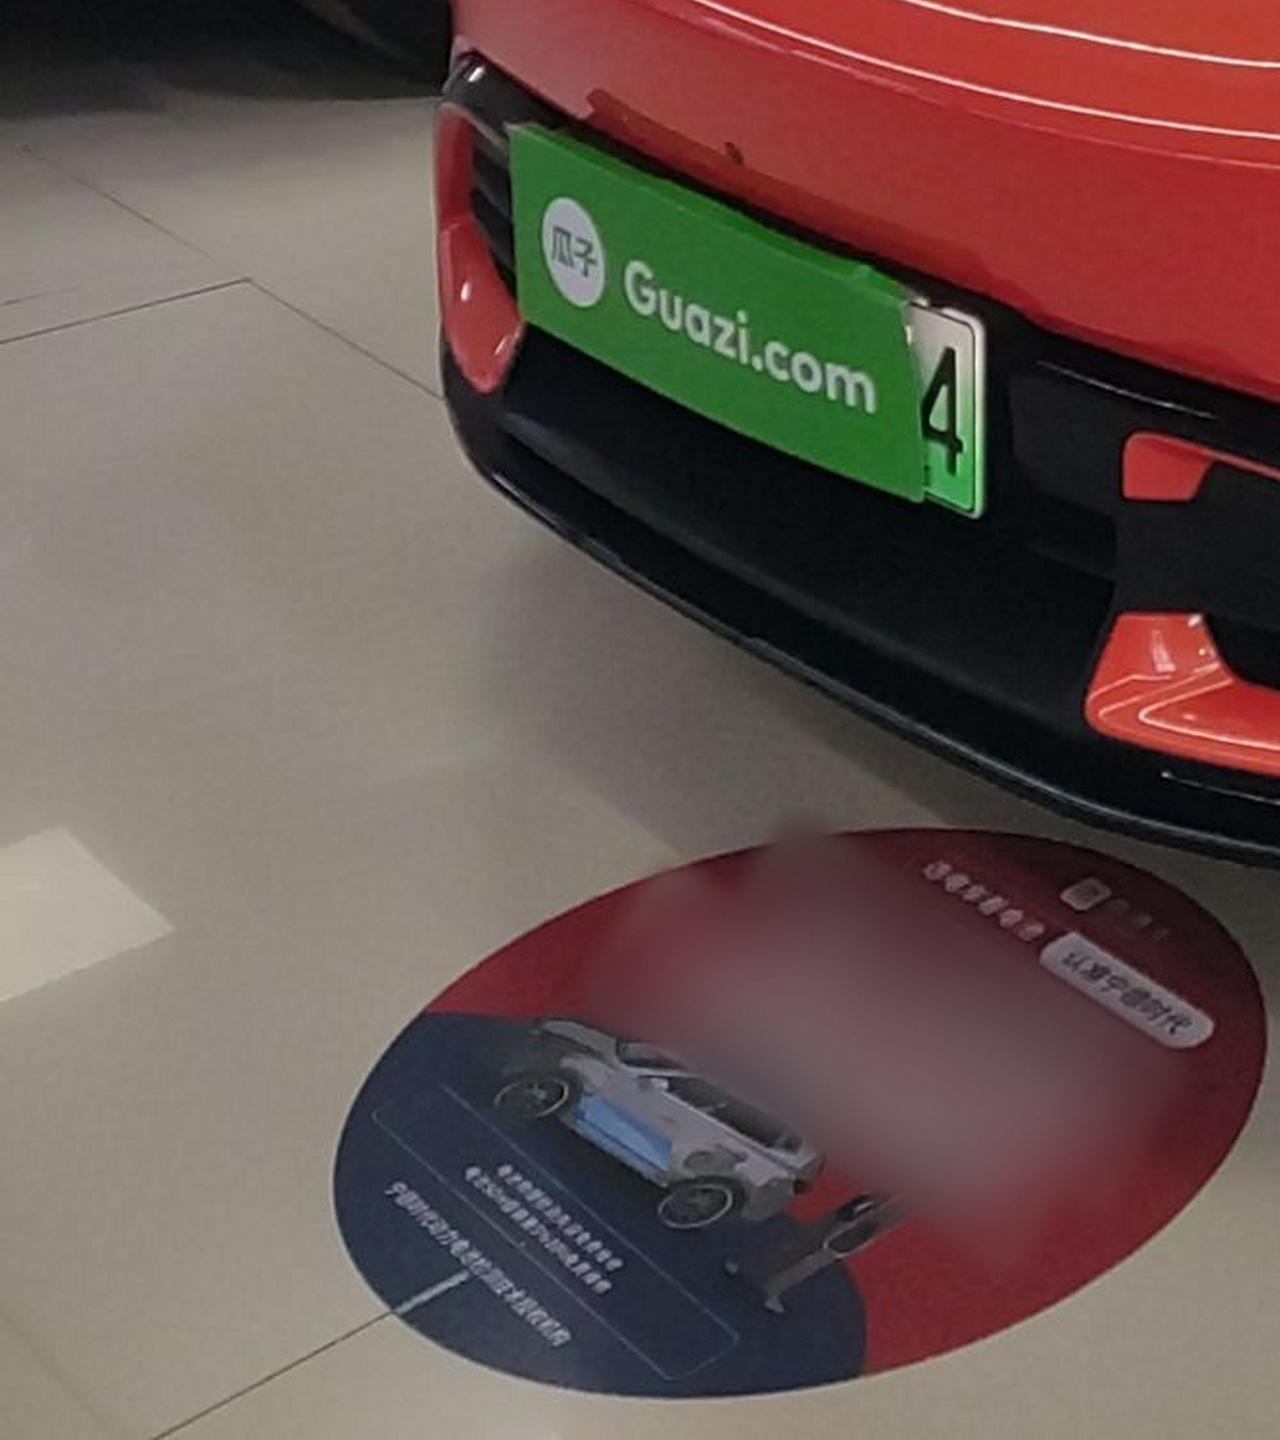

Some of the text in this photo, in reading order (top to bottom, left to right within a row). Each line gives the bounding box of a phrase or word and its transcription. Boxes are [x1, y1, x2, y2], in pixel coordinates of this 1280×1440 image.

[552, 225, 598, 278] 瓜子
[623, 259, 876, 415] Guazi.com
[920, 345, 964, 476] 4
